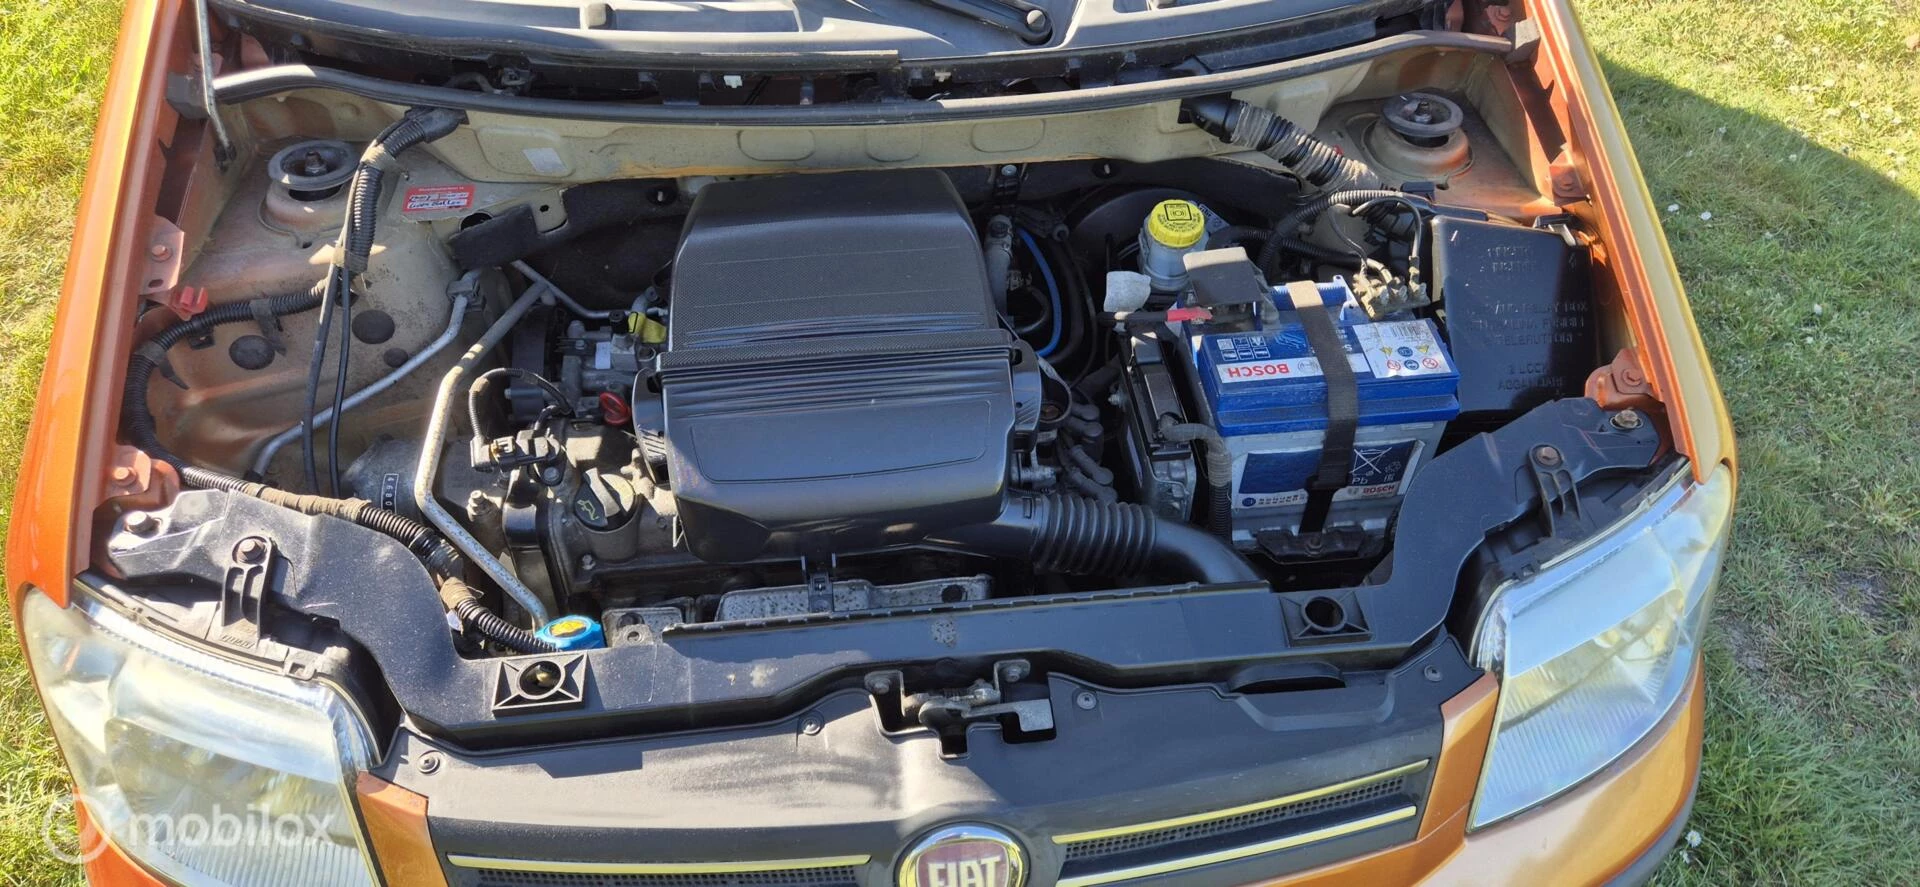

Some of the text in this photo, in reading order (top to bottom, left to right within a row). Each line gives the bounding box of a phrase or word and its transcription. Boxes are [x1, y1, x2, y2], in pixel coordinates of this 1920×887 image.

[1227, 363, 1290, 379] BOSCH
[1351, 477, 1368, 485] Pb
[1362, 484, 1395, 495] BOSCH
[928, 856, 1001, 887] FIAT
